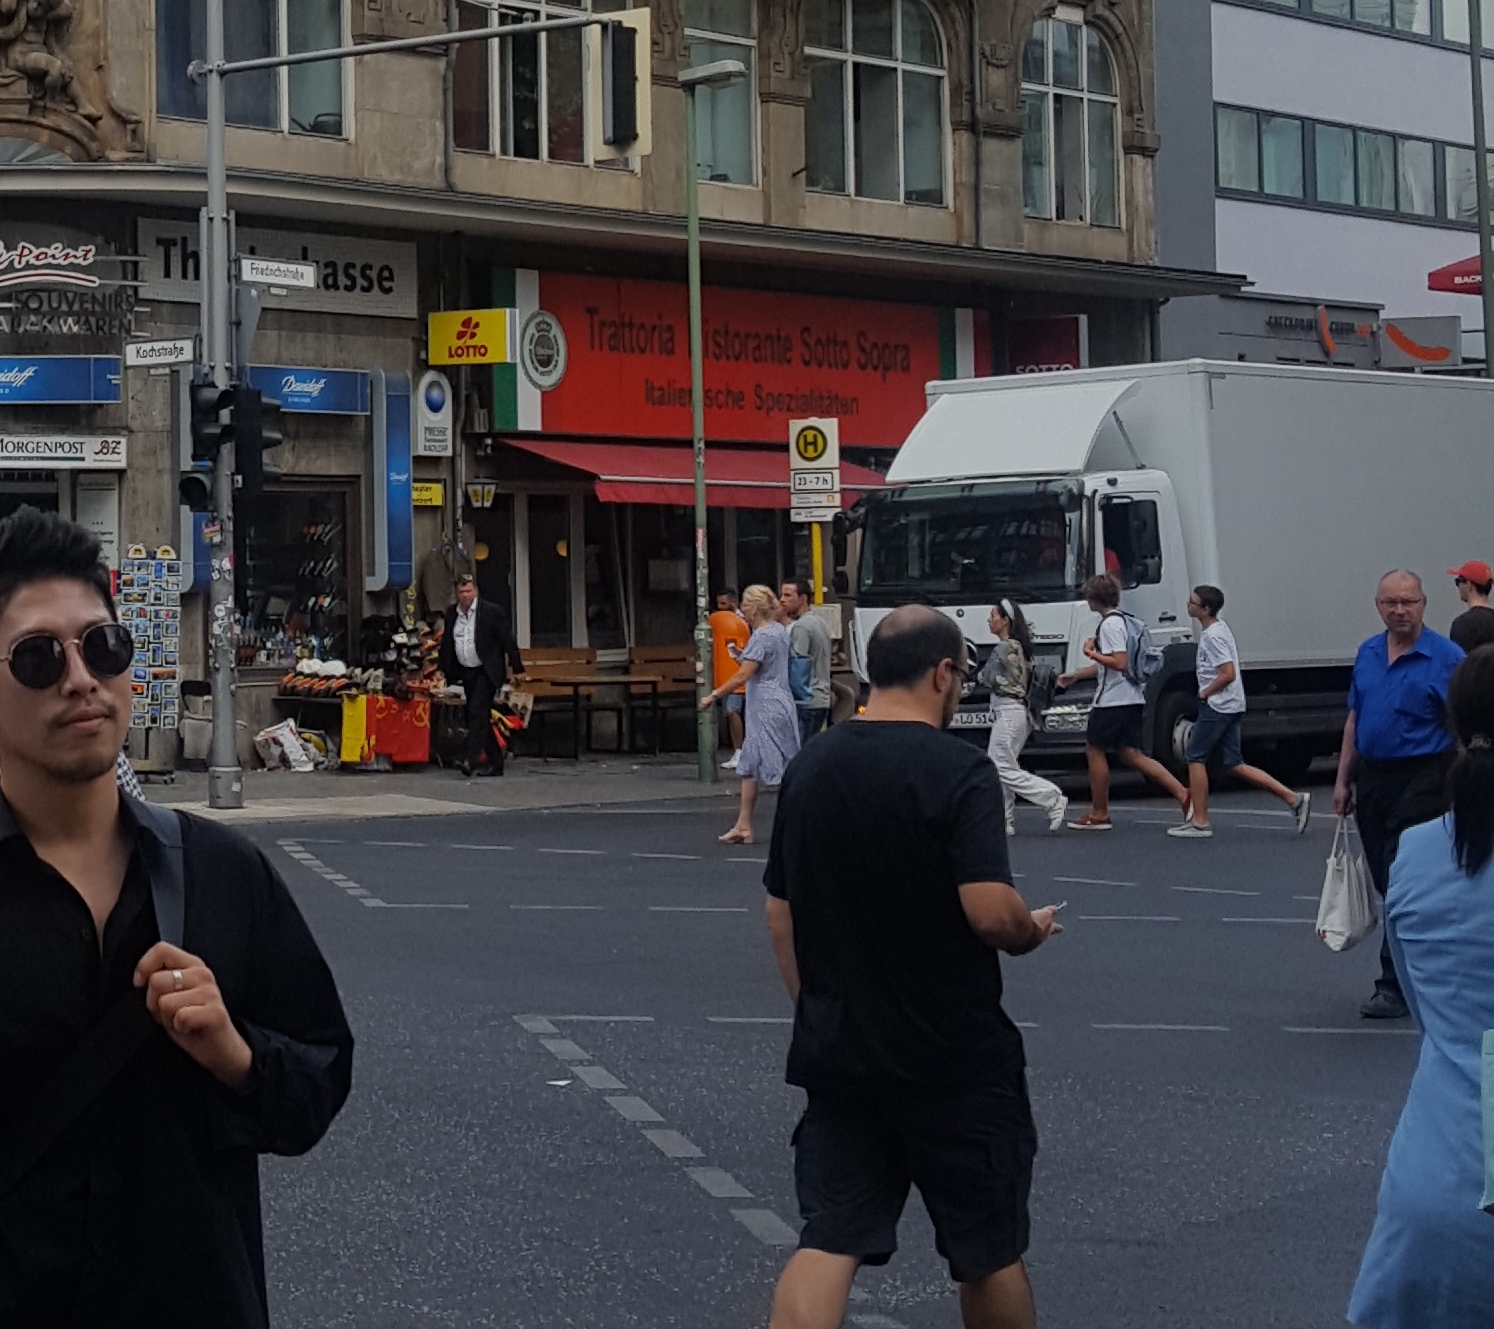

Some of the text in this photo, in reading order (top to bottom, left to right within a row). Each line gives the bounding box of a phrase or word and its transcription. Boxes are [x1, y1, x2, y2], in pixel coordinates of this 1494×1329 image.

[448, 344, 488, 359] LOTTO
[584, 306, 675, 357] Trattoria
[688, 316, 793, 366] istorante
[799, 325, 850, 370] Sotto
[857, 330, 911, 382] Sopra
[753, 383, 860, 417] Spezialitäten
